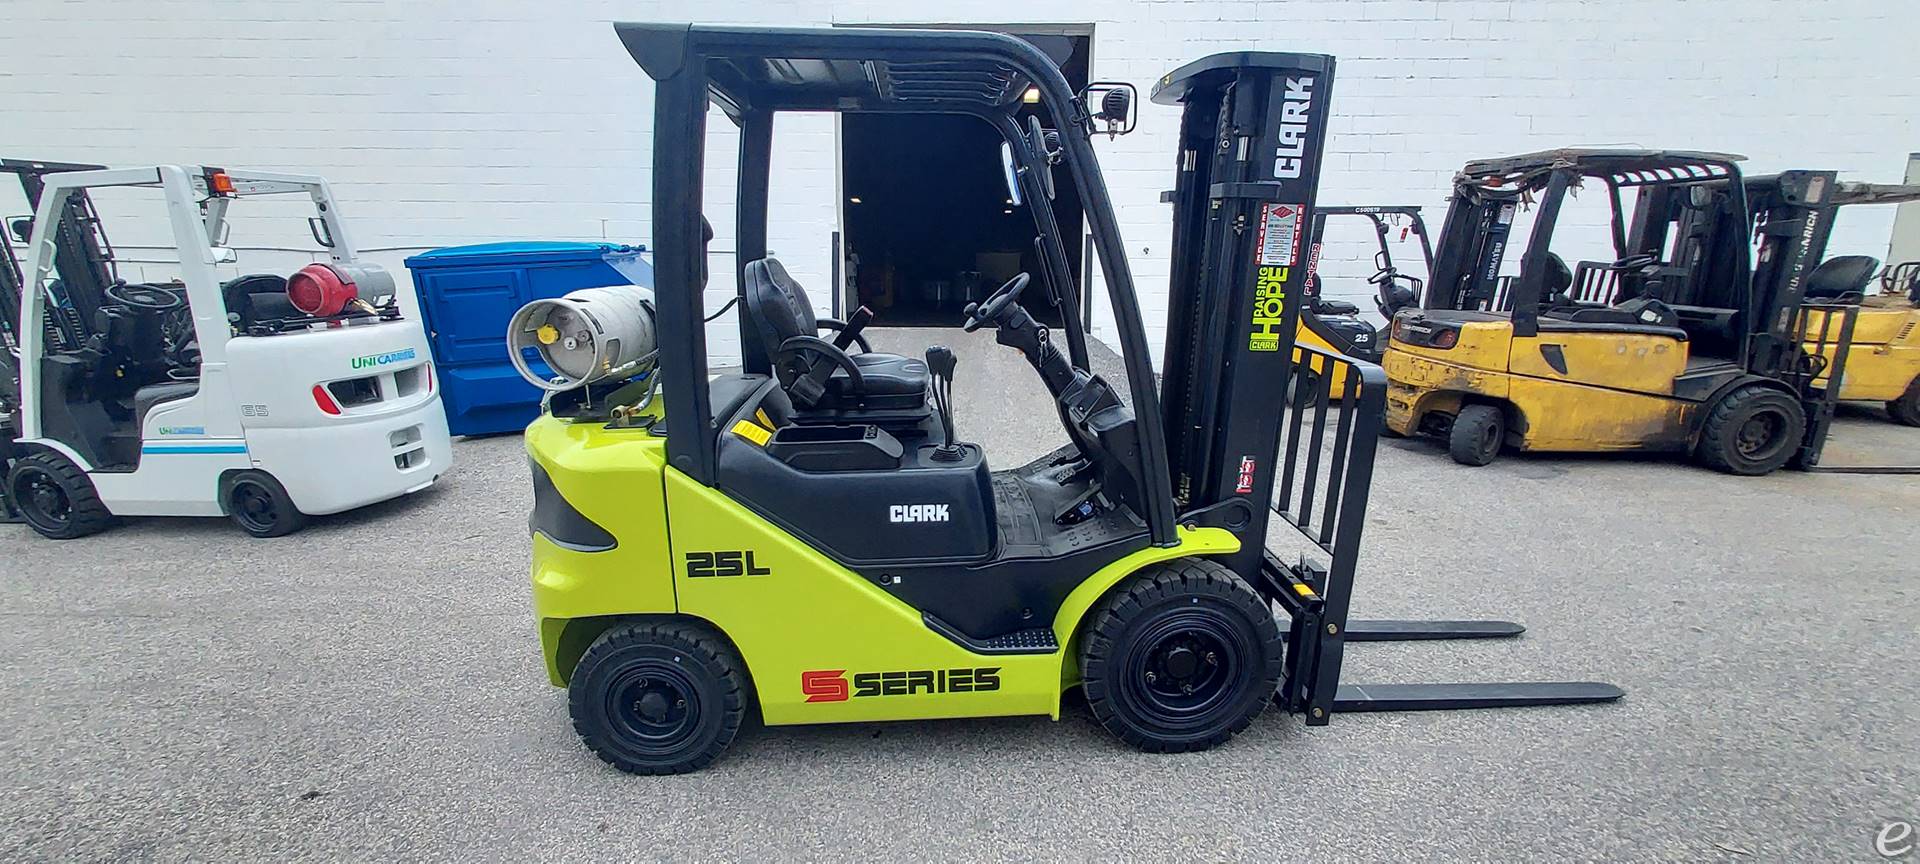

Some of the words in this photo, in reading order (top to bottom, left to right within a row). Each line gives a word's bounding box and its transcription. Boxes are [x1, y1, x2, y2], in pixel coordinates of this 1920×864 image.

[1274, 77, 1314, 178] CLARK
[1256, 205, 1268, 262] SERVICE
[1291, 206, 1304, 263] RENTALS
[1303, 243, 1320, 296] RENTAL
[1486, 242, 1503, 280] KOMATSU
[1251, 267, 1289, 340] HOPE
[1253, 267, 1269, 317] RAISING
[1251, 341, 1277, 349] CLARK
[1355, 333, 1368, 342] 25
[241, 404, 269, 416] 65
[890, 504, 949, 522] CLARK
[686, 551, 770, 577] 25L
[853, 667, 1001, 697] SERIES
